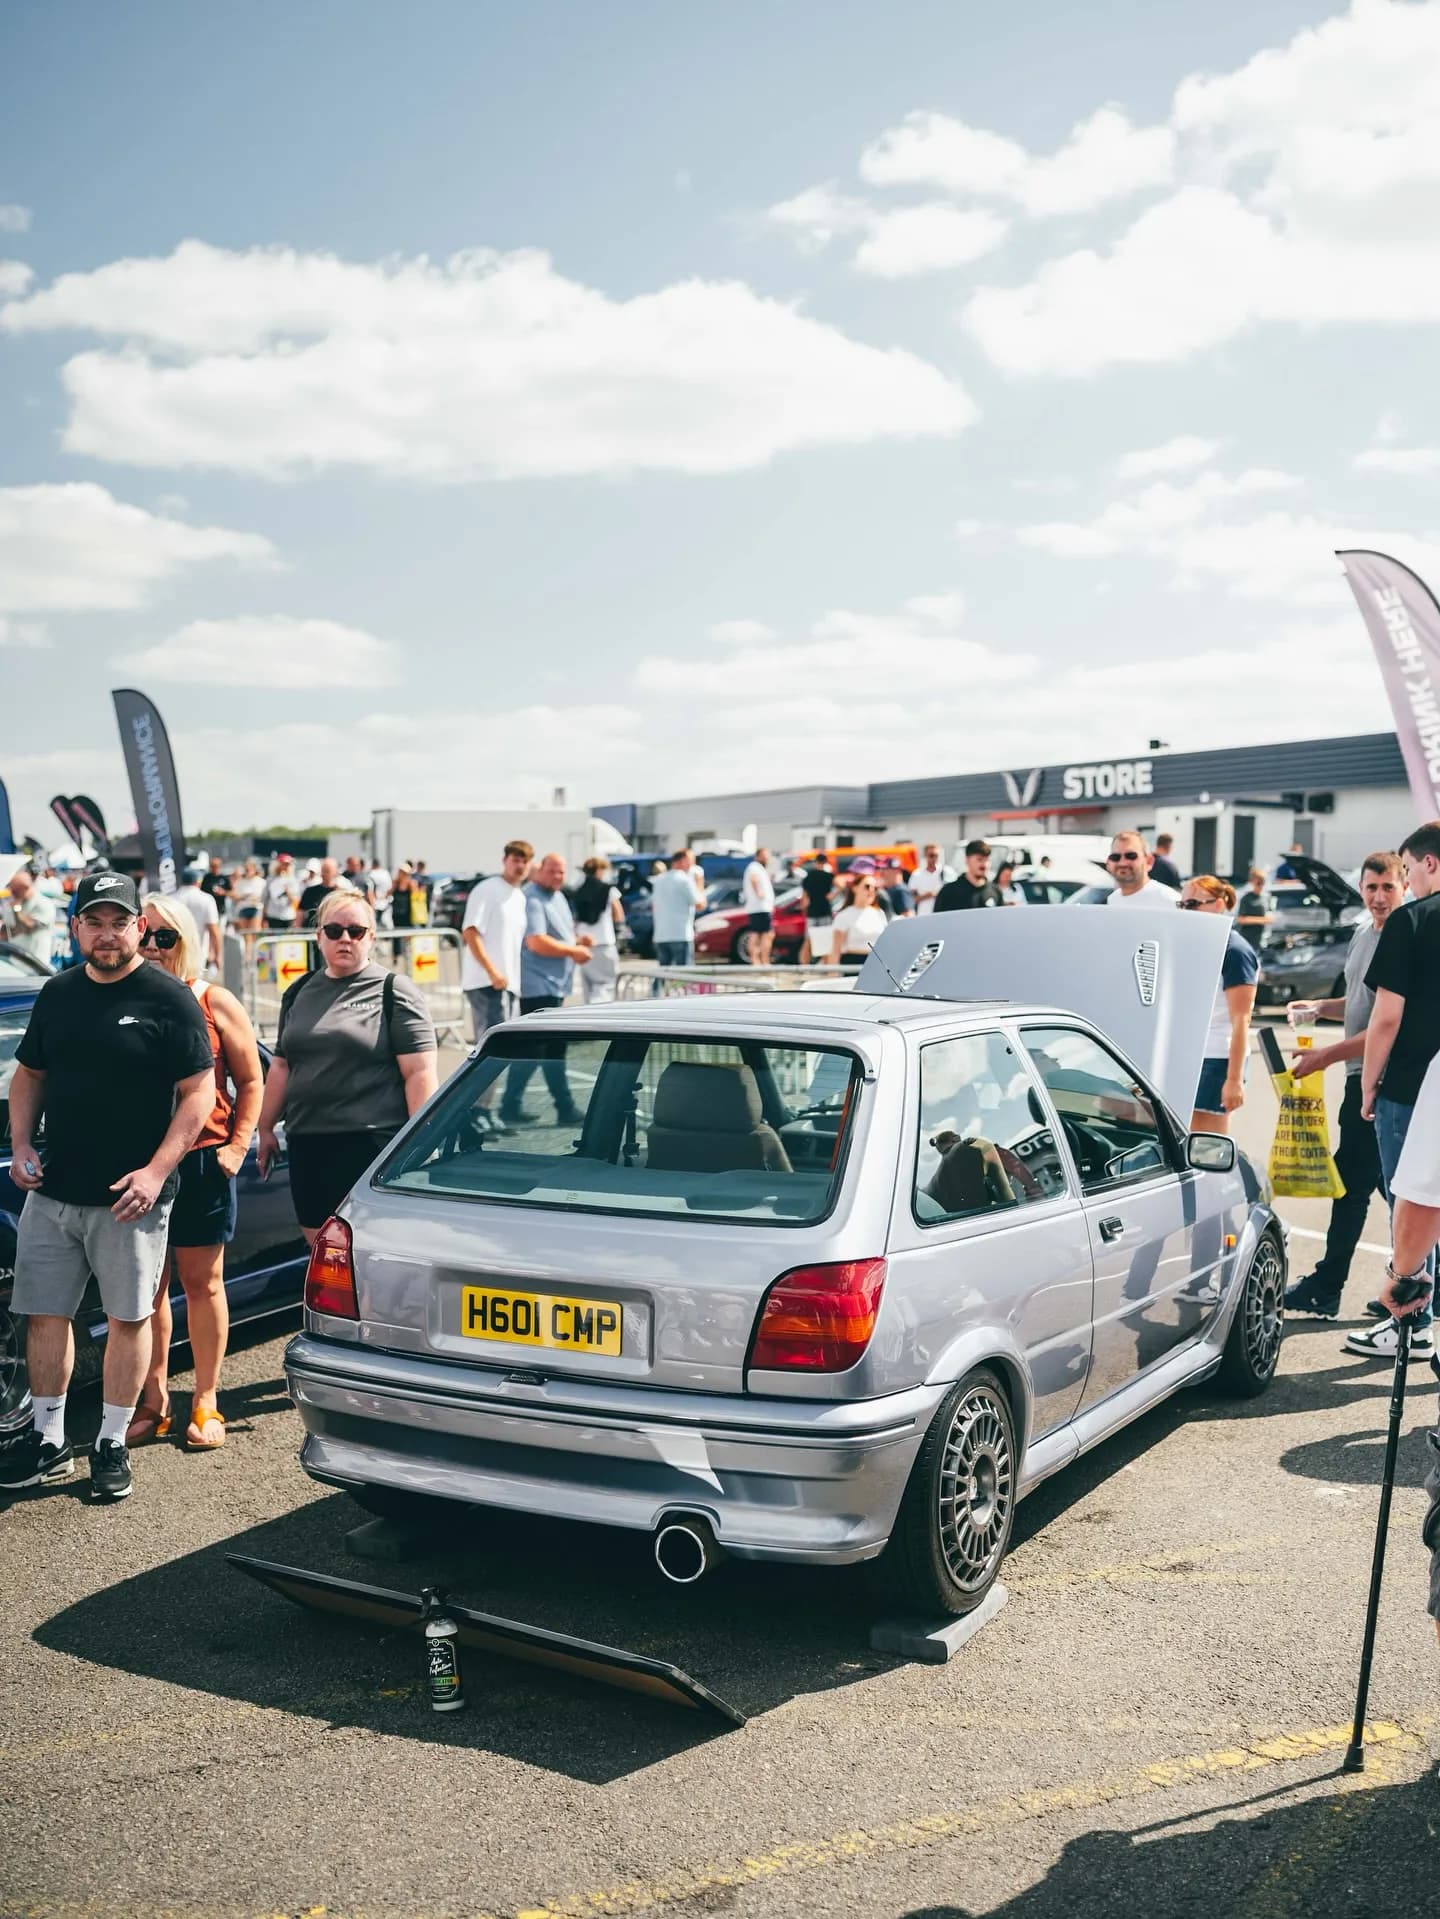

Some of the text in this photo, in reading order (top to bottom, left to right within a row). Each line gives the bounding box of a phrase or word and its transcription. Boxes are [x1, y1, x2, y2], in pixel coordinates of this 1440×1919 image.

[1063, 761, 1154, 800] STORE
[468, 1293, 617, 1346] H601 CMP
